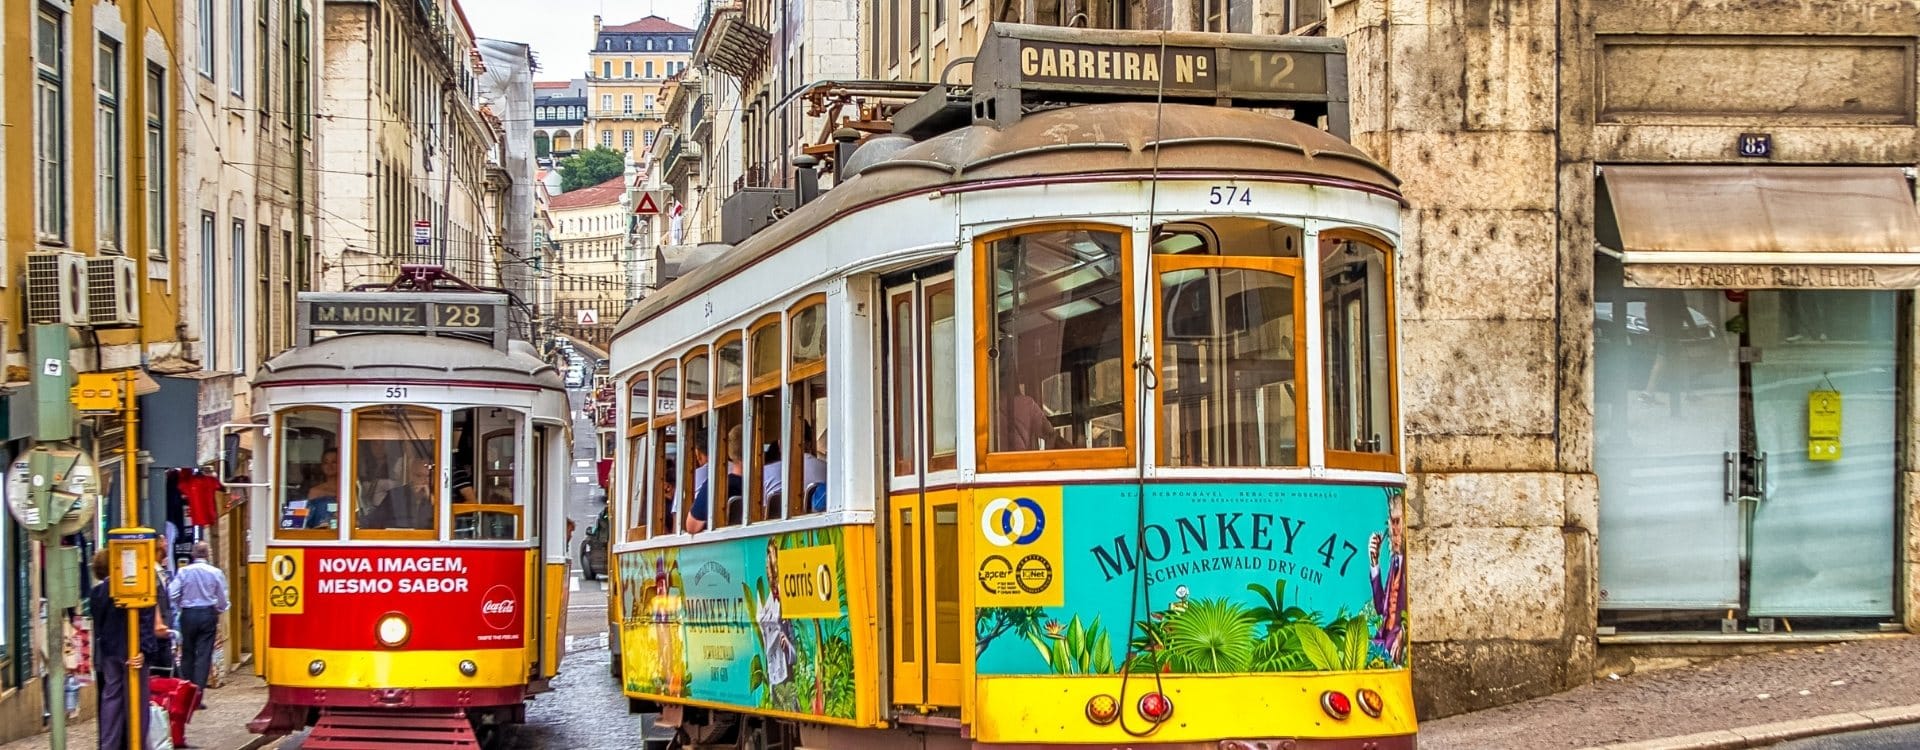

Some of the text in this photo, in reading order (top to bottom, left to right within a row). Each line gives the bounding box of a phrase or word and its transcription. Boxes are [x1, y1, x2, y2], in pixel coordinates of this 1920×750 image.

[1021, 47, 1208, 84] CARREIRA Nº
[1249, 52, 1296, 90] 12
[1210, 186, 1252, 206] 574
[343, 306, 417, 322] MONIZ
[445, 305, 481, 328] 28
[386, 387, 408, 399] 551
[1089, 512, 1359, 582] MONKEY 47
[319, 557, 468, 574] NOVA IMAGEM,
[1146, 556, 1324, 587] SCHWARZWALD DRY GIN
[318, 578, 469, 594] MESMO SABOR
[783, 562, 814, 598] carris
